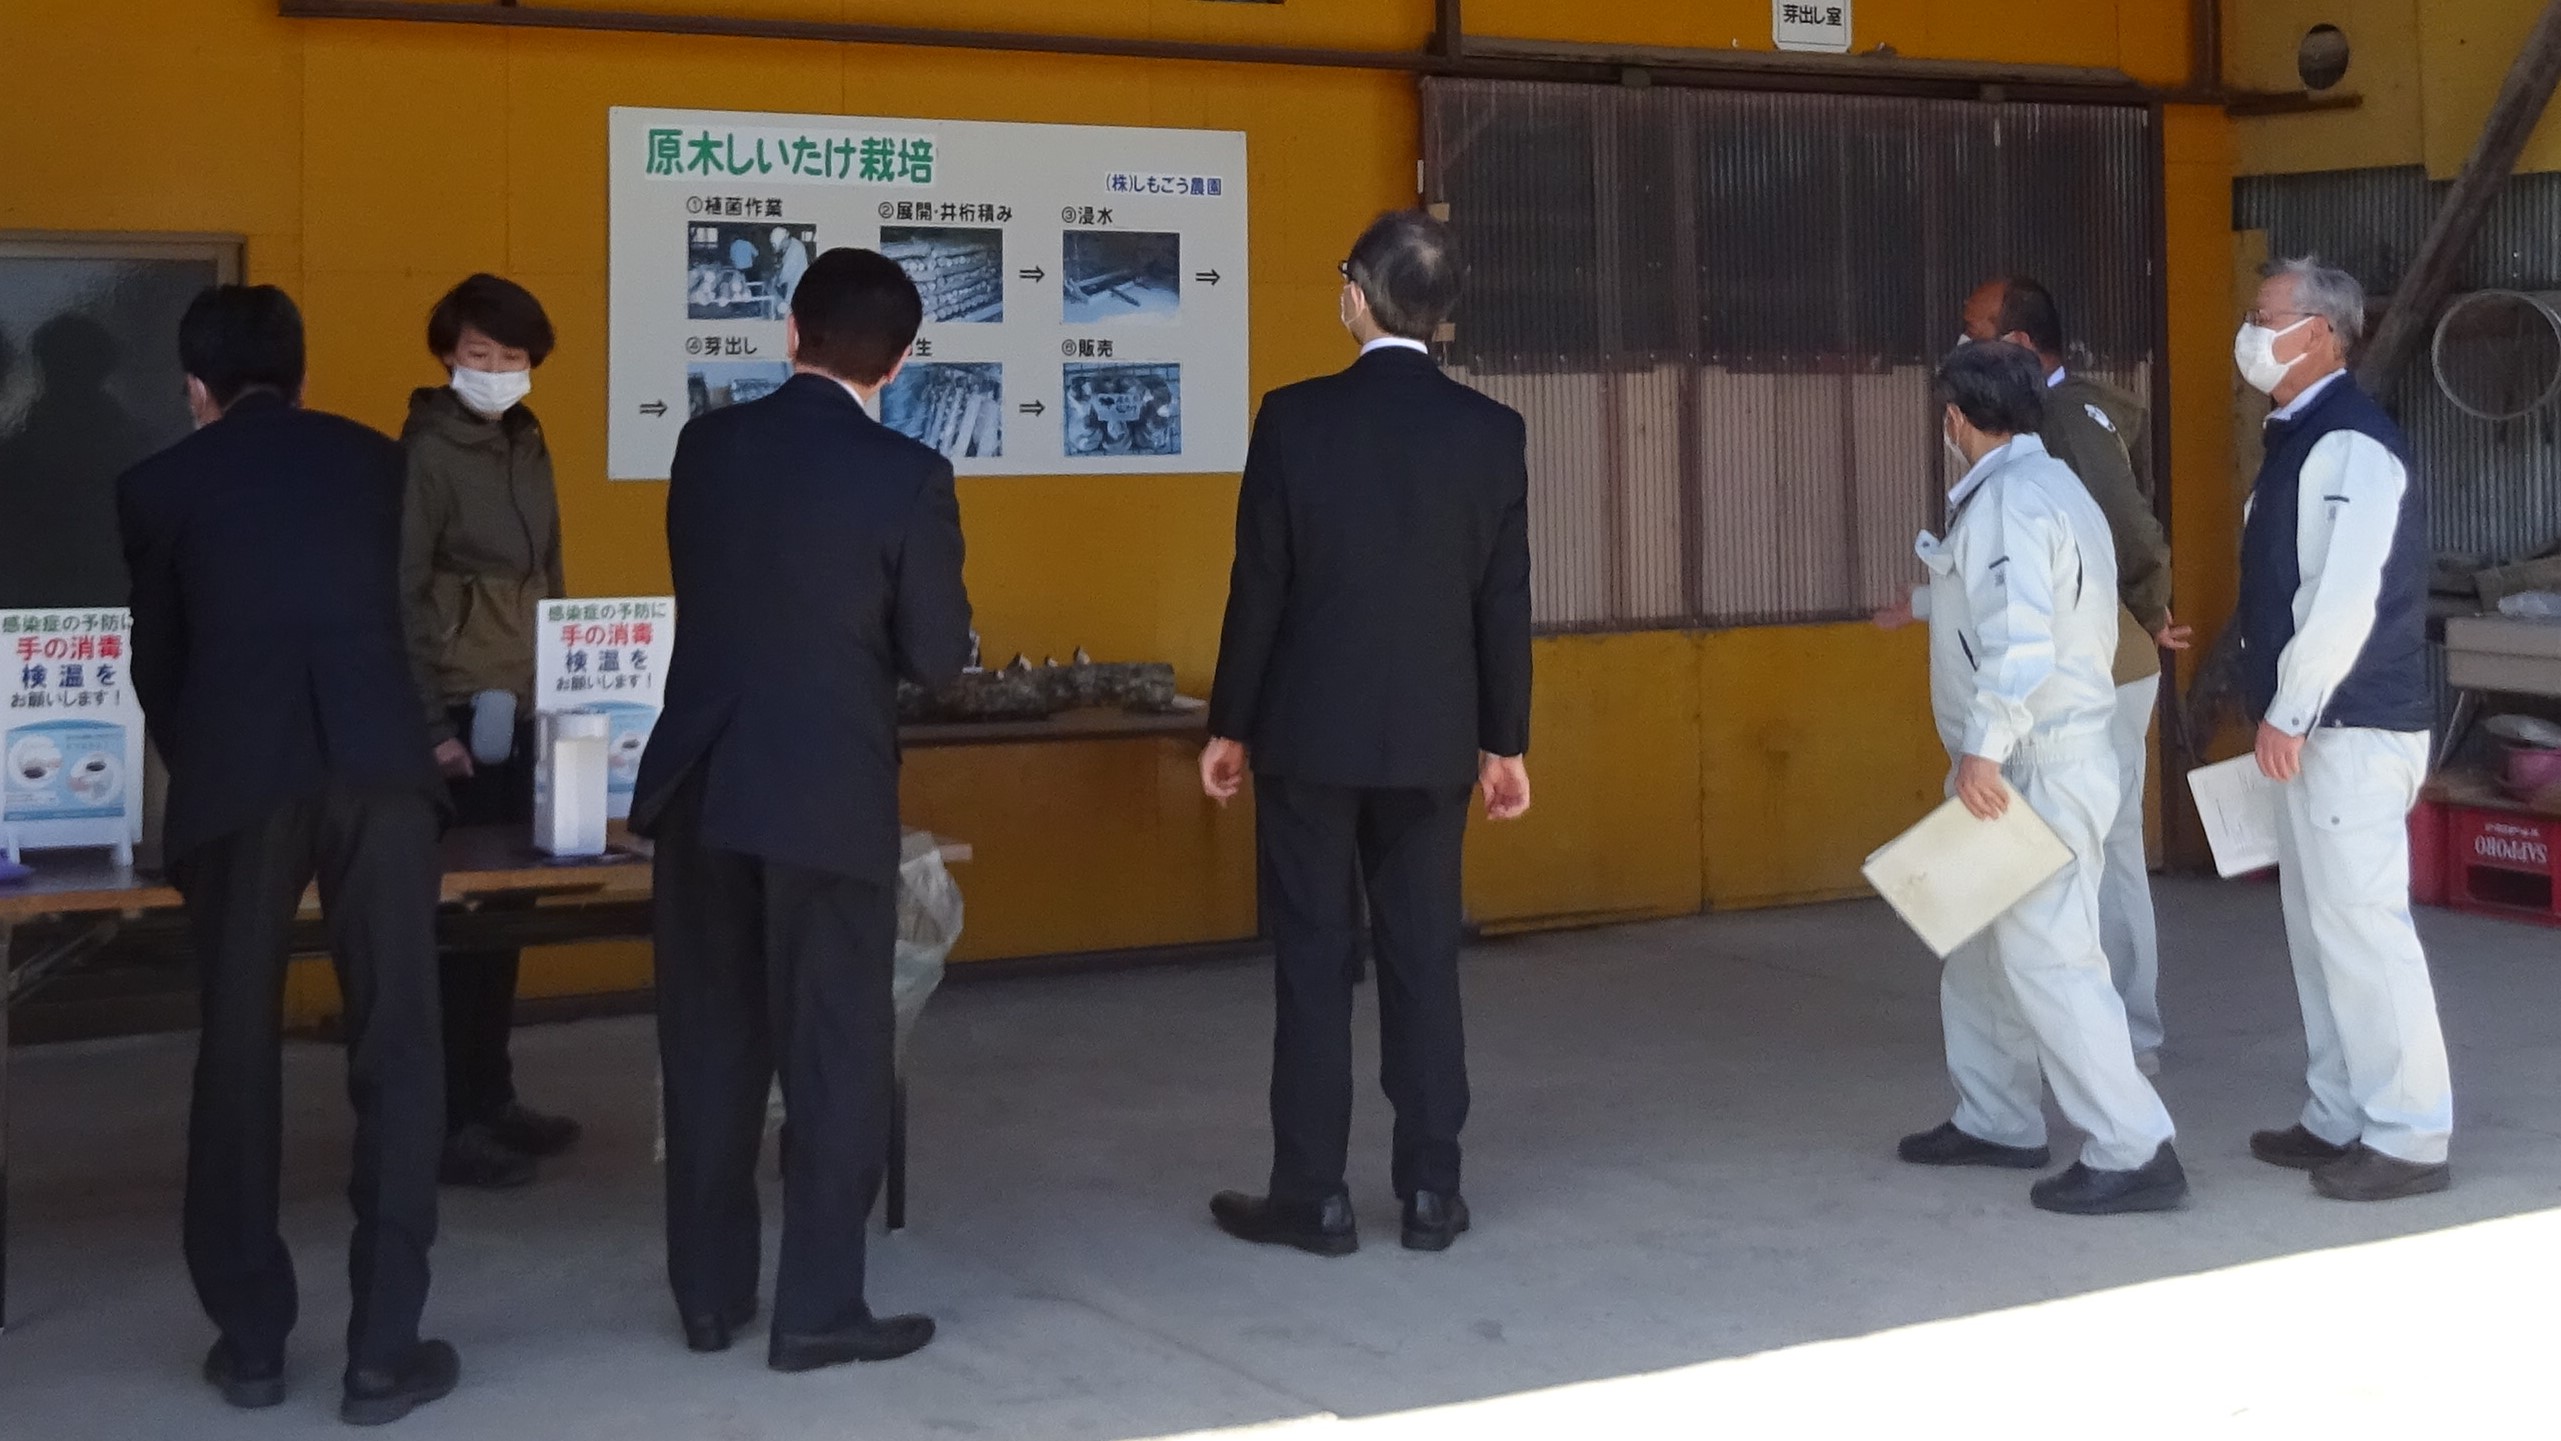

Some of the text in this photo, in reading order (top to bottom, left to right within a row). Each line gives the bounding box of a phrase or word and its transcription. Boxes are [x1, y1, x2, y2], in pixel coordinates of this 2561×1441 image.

[1783, 4, 1842, 26] 芽出し室
[646, 128, 933, 183] 原木しいたけ栽培
[1106, 173, 1222, 197] (株)しもごう農園
[548, 602, 667, 621] 感染症の予防に
[562, 622, 654, 646] 手の消毒
[16, 634, 123, 661] 手の消毒
[2475, 835, 2547, 864] SAPPORO
